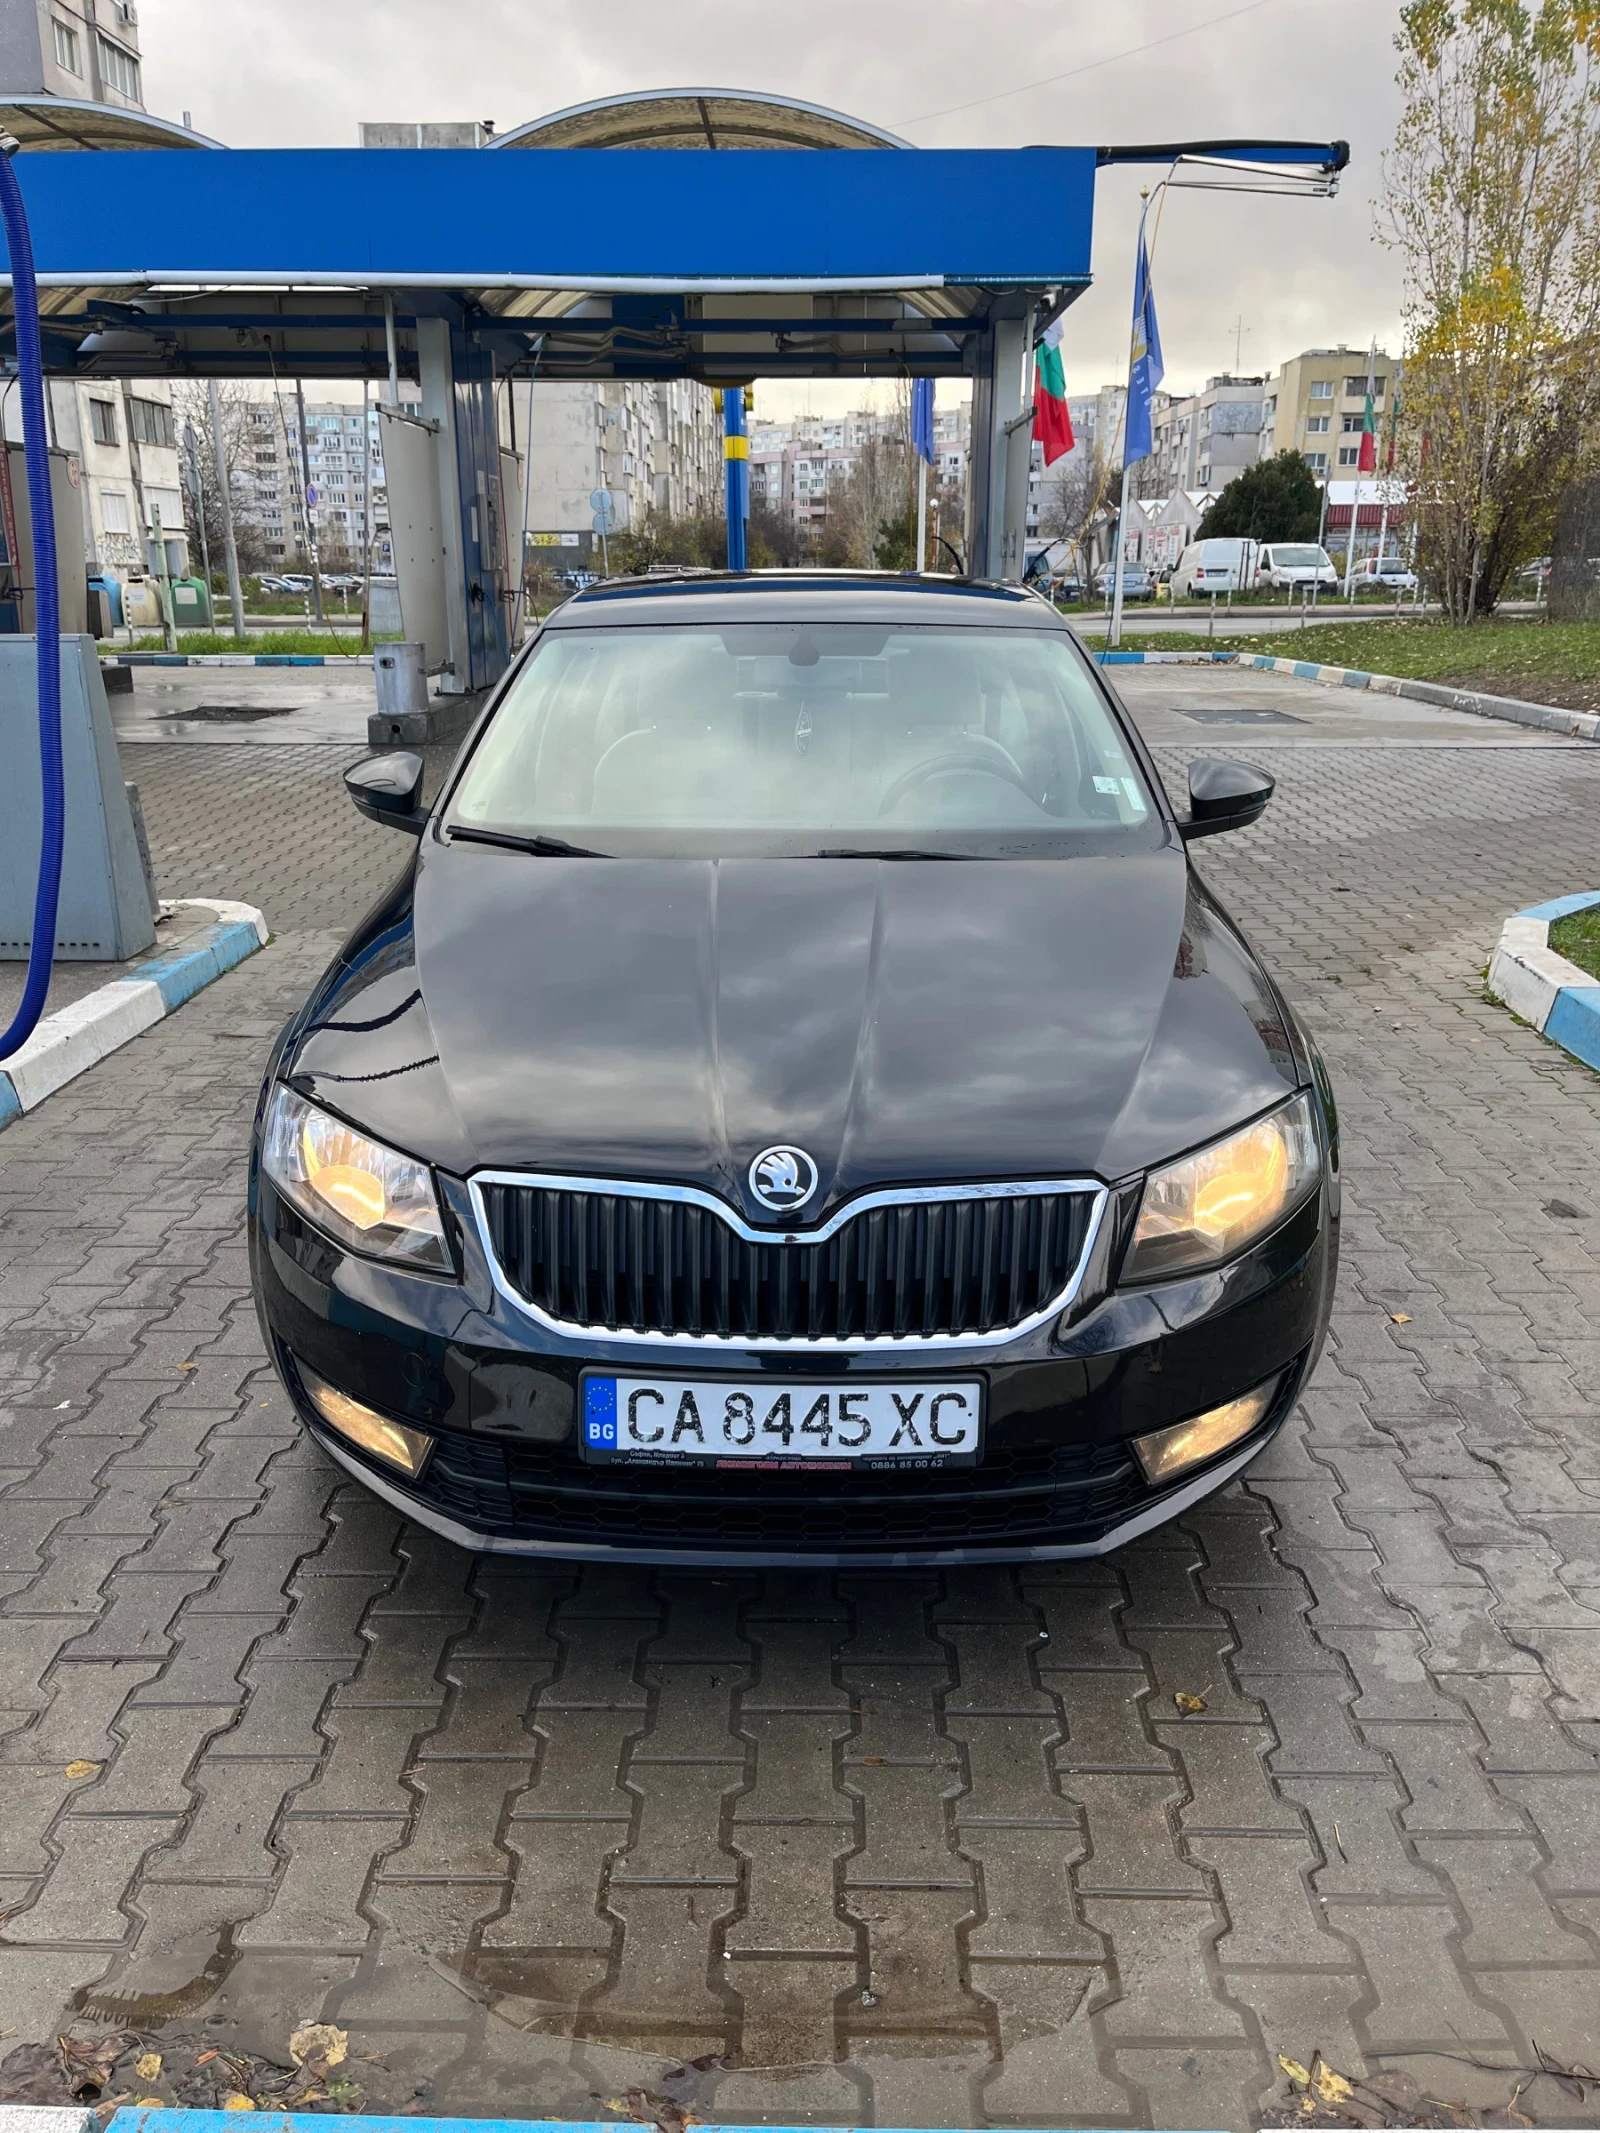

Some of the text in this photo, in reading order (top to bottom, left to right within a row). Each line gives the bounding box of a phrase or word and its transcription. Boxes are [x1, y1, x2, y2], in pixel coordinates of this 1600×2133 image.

[628, 1388, 968, 1446] CA 8445 XC
[588, 1422, 614, 1440] BG
[871, 1459, 944, 1470] 0886 85 00 62
